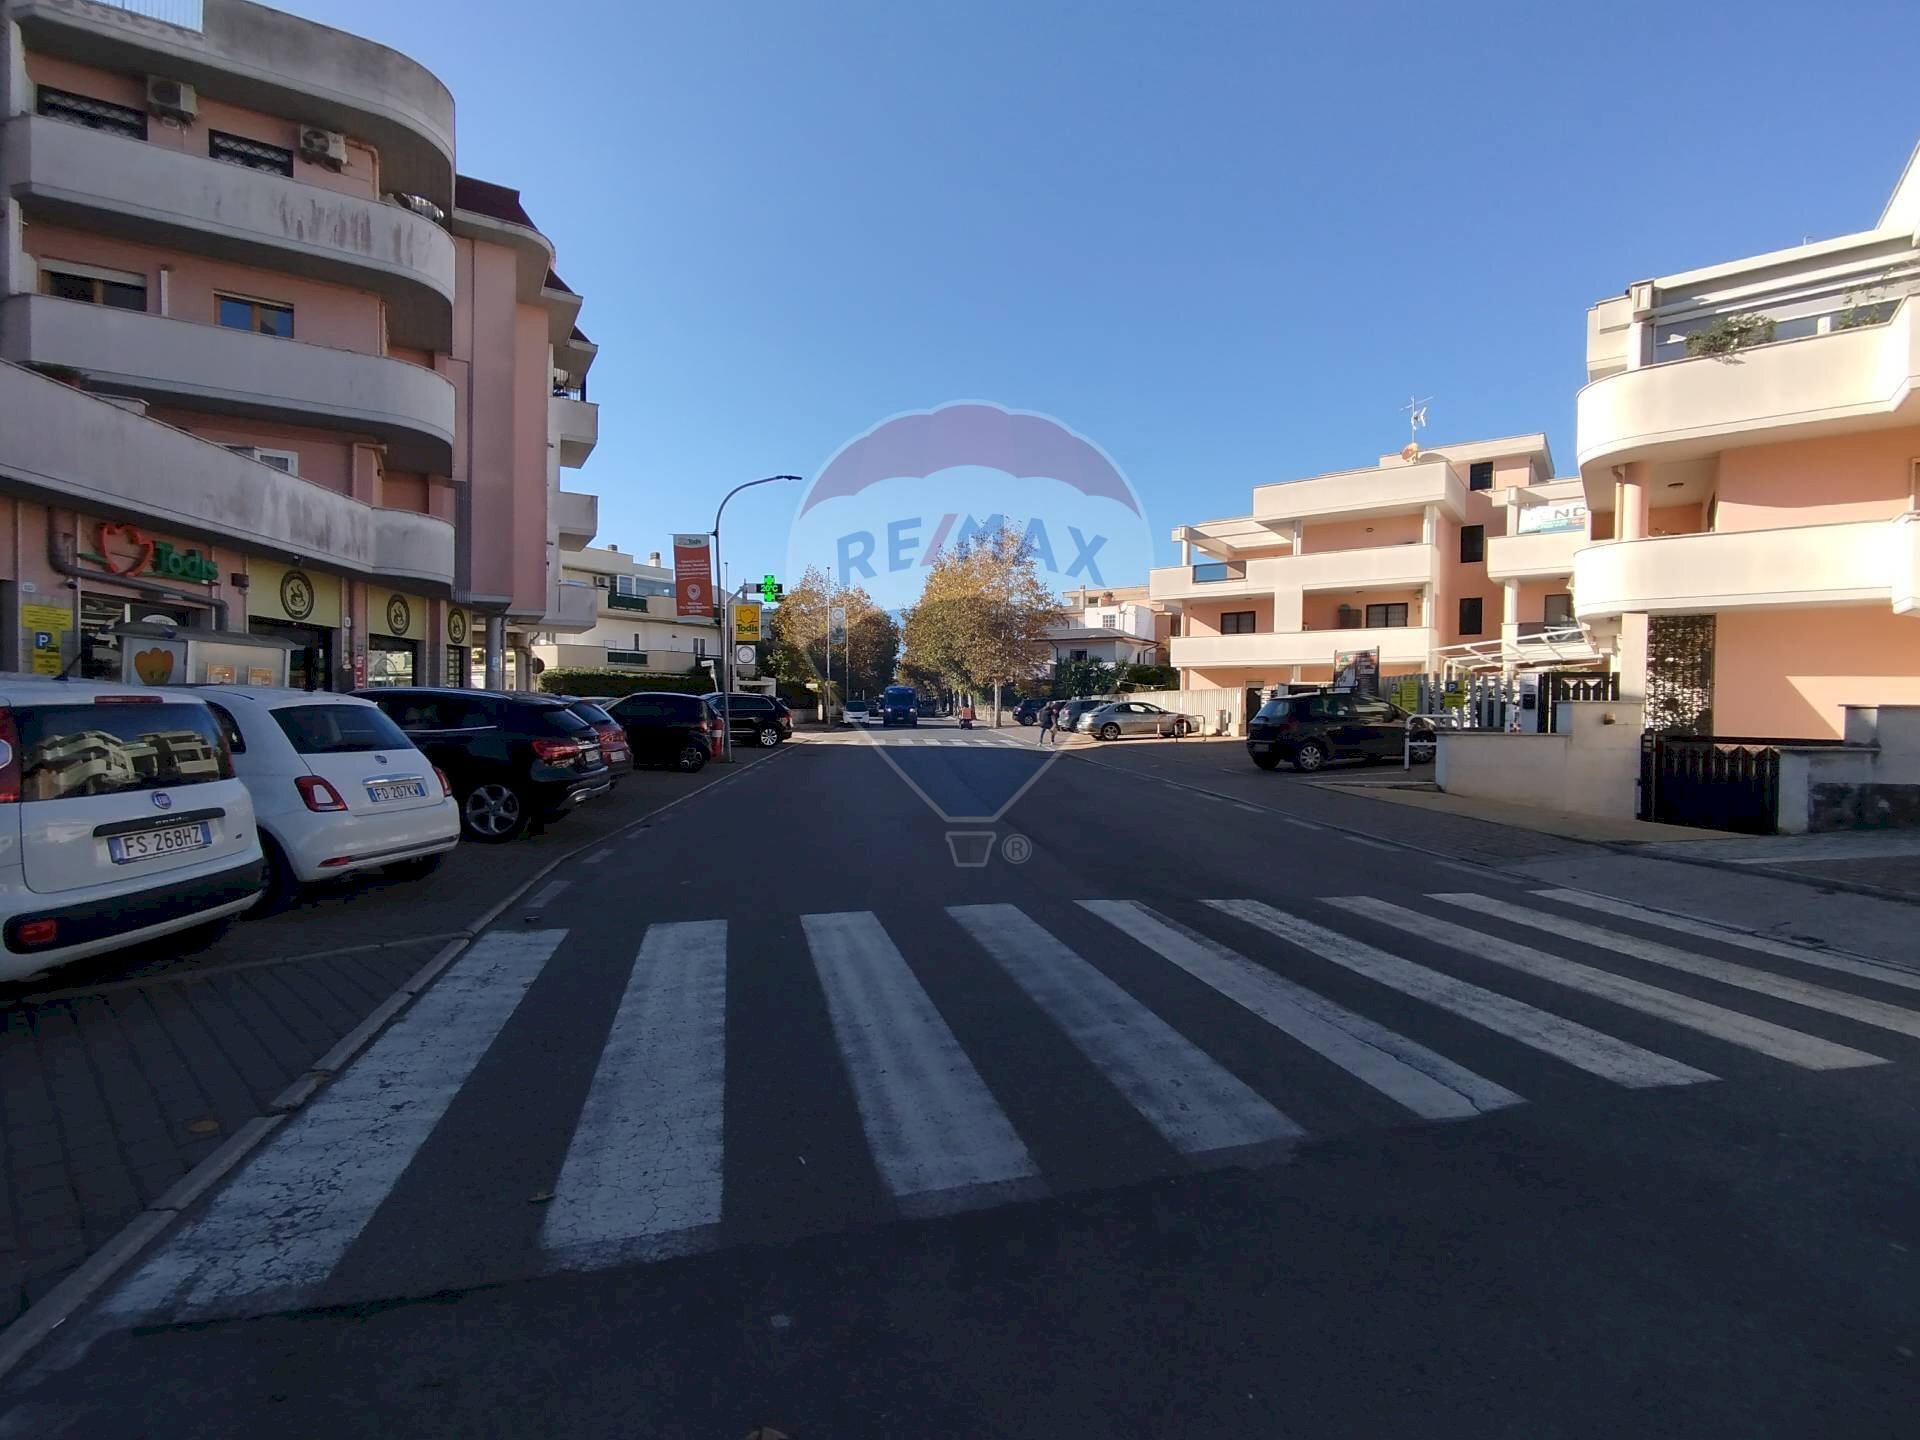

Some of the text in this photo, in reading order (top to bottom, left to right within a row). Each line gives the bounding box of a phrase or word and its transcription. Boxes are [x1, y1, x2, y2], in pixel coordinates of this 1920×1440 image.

[154, 540, 219, 581] Todis
[736, 623, 759, 633] Todis
[39, 634, 49, 647] P
[123, 826, 202, 857] FS 268HZ
